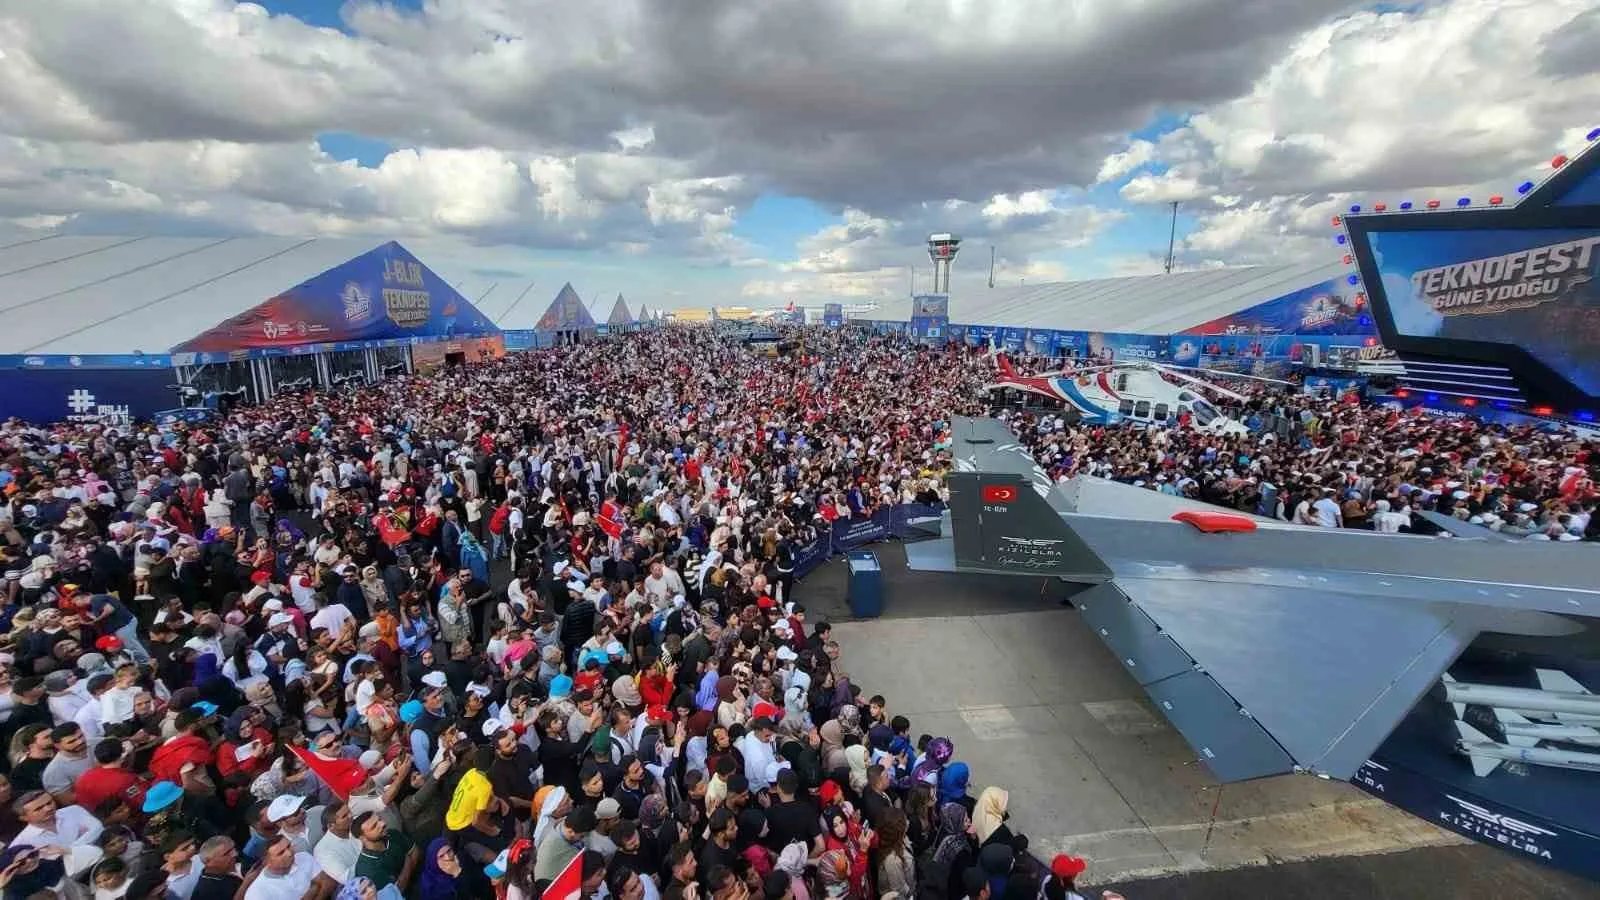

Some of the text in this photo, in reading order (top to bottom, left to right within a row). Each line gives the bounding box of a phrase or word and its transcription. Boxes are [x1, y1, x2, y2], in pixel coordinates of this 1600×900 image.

[1411, 236, 1600, 298] TEKNOFEST
[382, 288, 430, 310] TEKNOFEST
[1432, 277, 1561, 309] GÜNEYDOĞU
[1440, 811, 1553, 860] KIZILELMA
